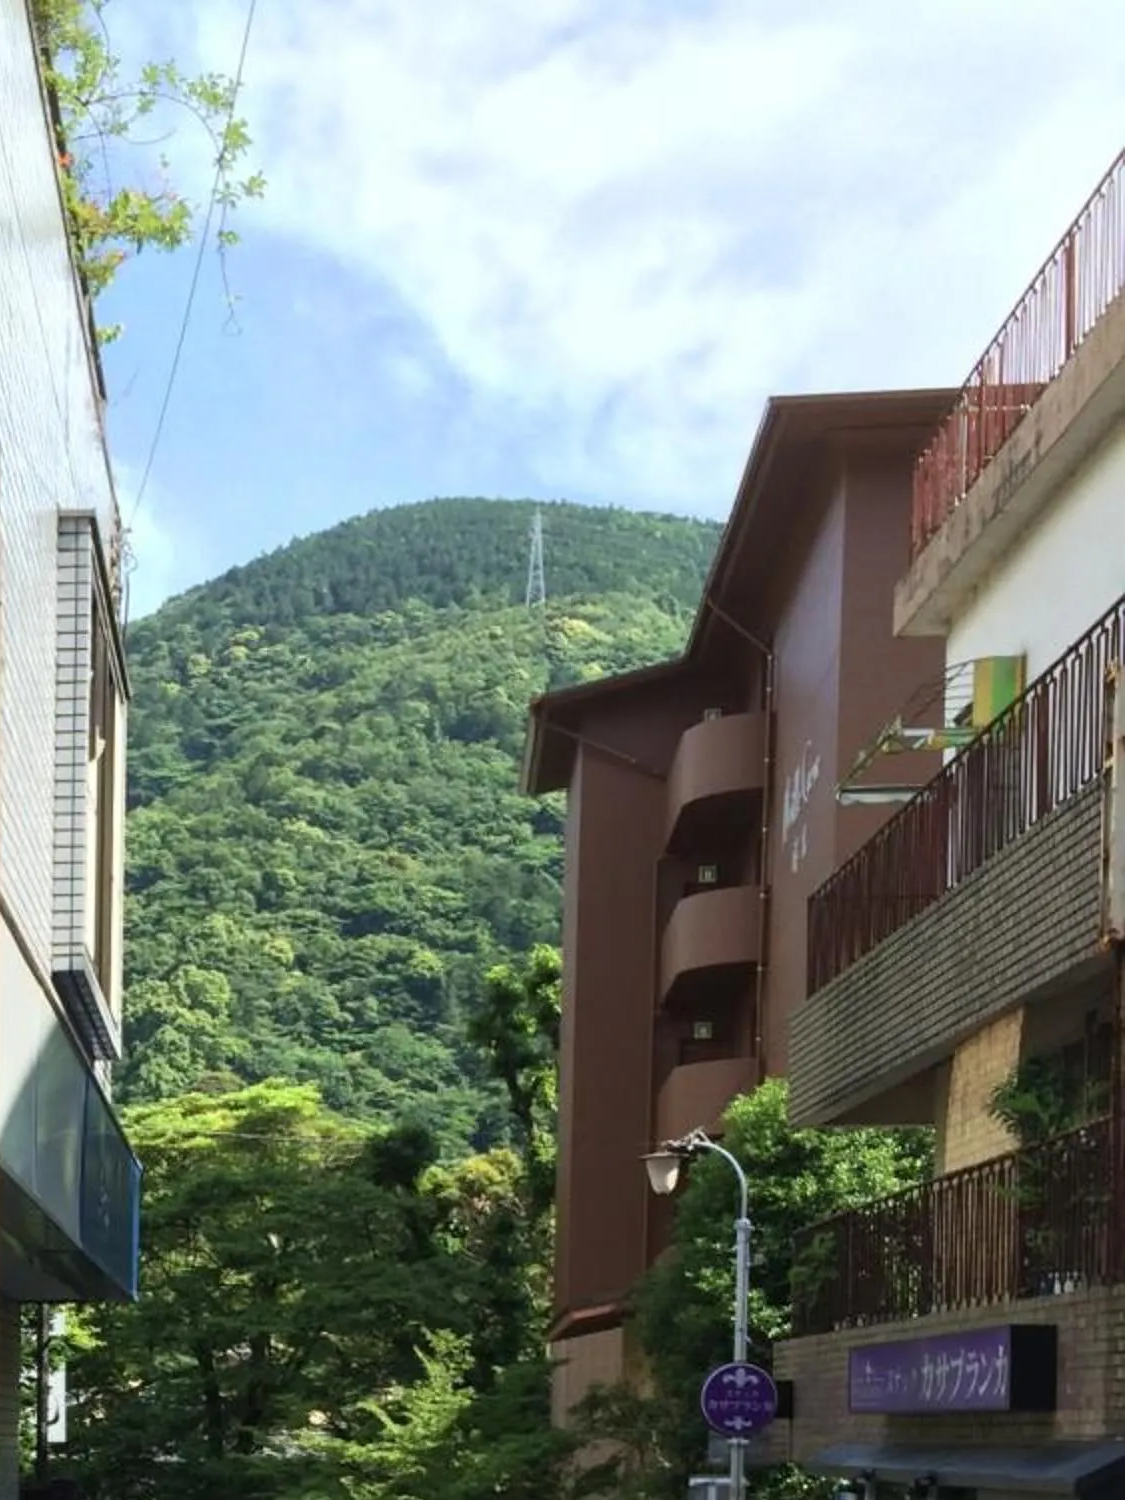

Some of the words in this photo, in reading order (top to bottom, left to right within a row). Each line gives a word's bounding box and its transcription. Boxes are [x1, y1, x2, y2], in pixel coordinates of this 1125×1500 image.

[920, 1345, 1008, 1401] カサブランカ
